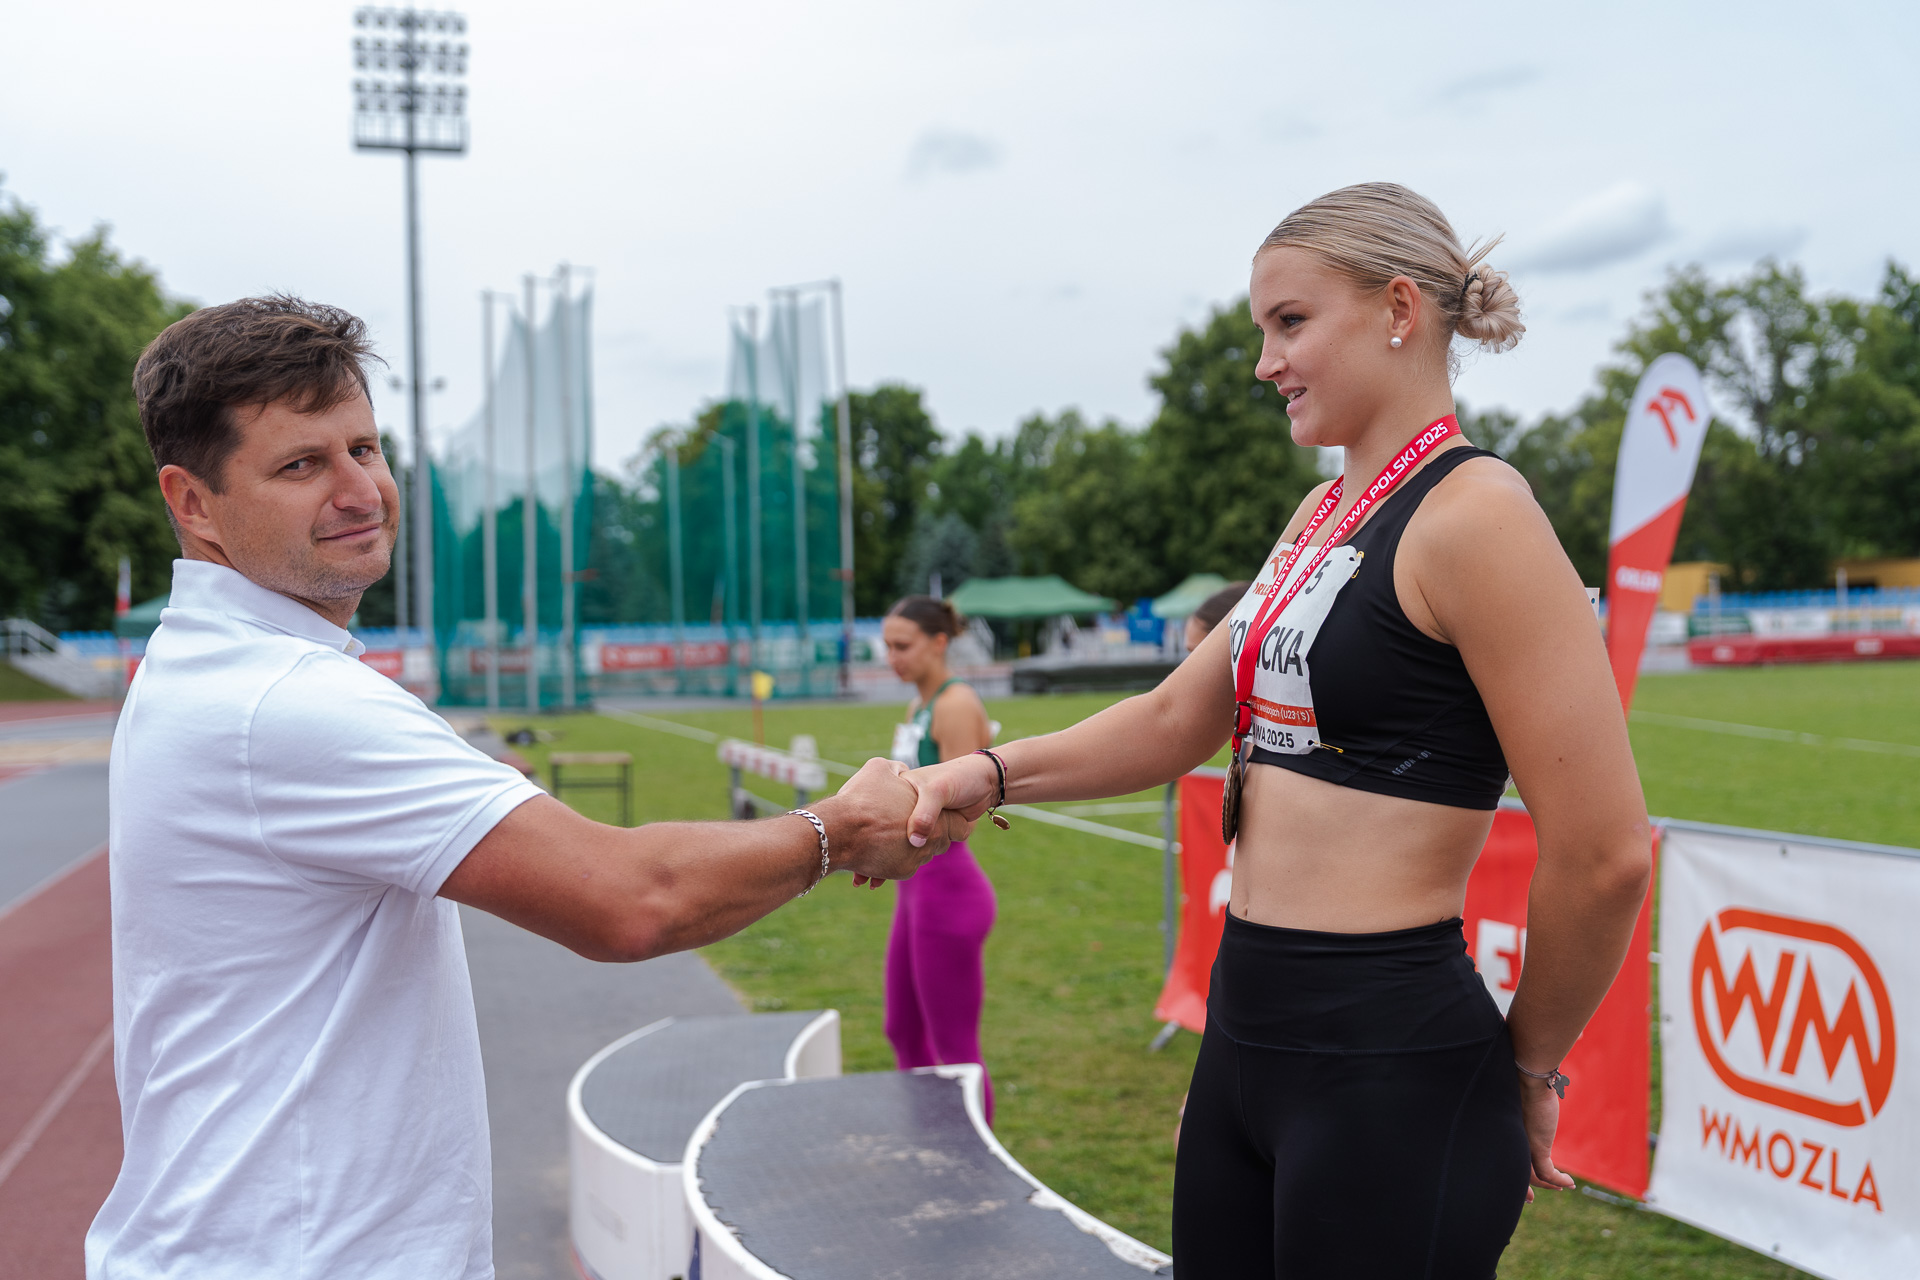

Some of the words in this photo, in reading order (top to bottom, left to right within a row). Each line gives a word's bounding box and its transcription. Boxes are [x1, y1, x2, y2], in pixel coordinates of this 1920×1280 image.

[1267, 497, 1337, 599] MISTRZOSTWA
[1286, 498, 1371, 601] MISTRZOSTWA
[1369, 447, 1418, 499] POLSKI
[1415, 422, 1449, 453] 2025
[1305, 560, 1332, 595] 5
[1266, 728, 1295, 749] 2025
[1699, 1103, 1884, 1214] WMOZLA
